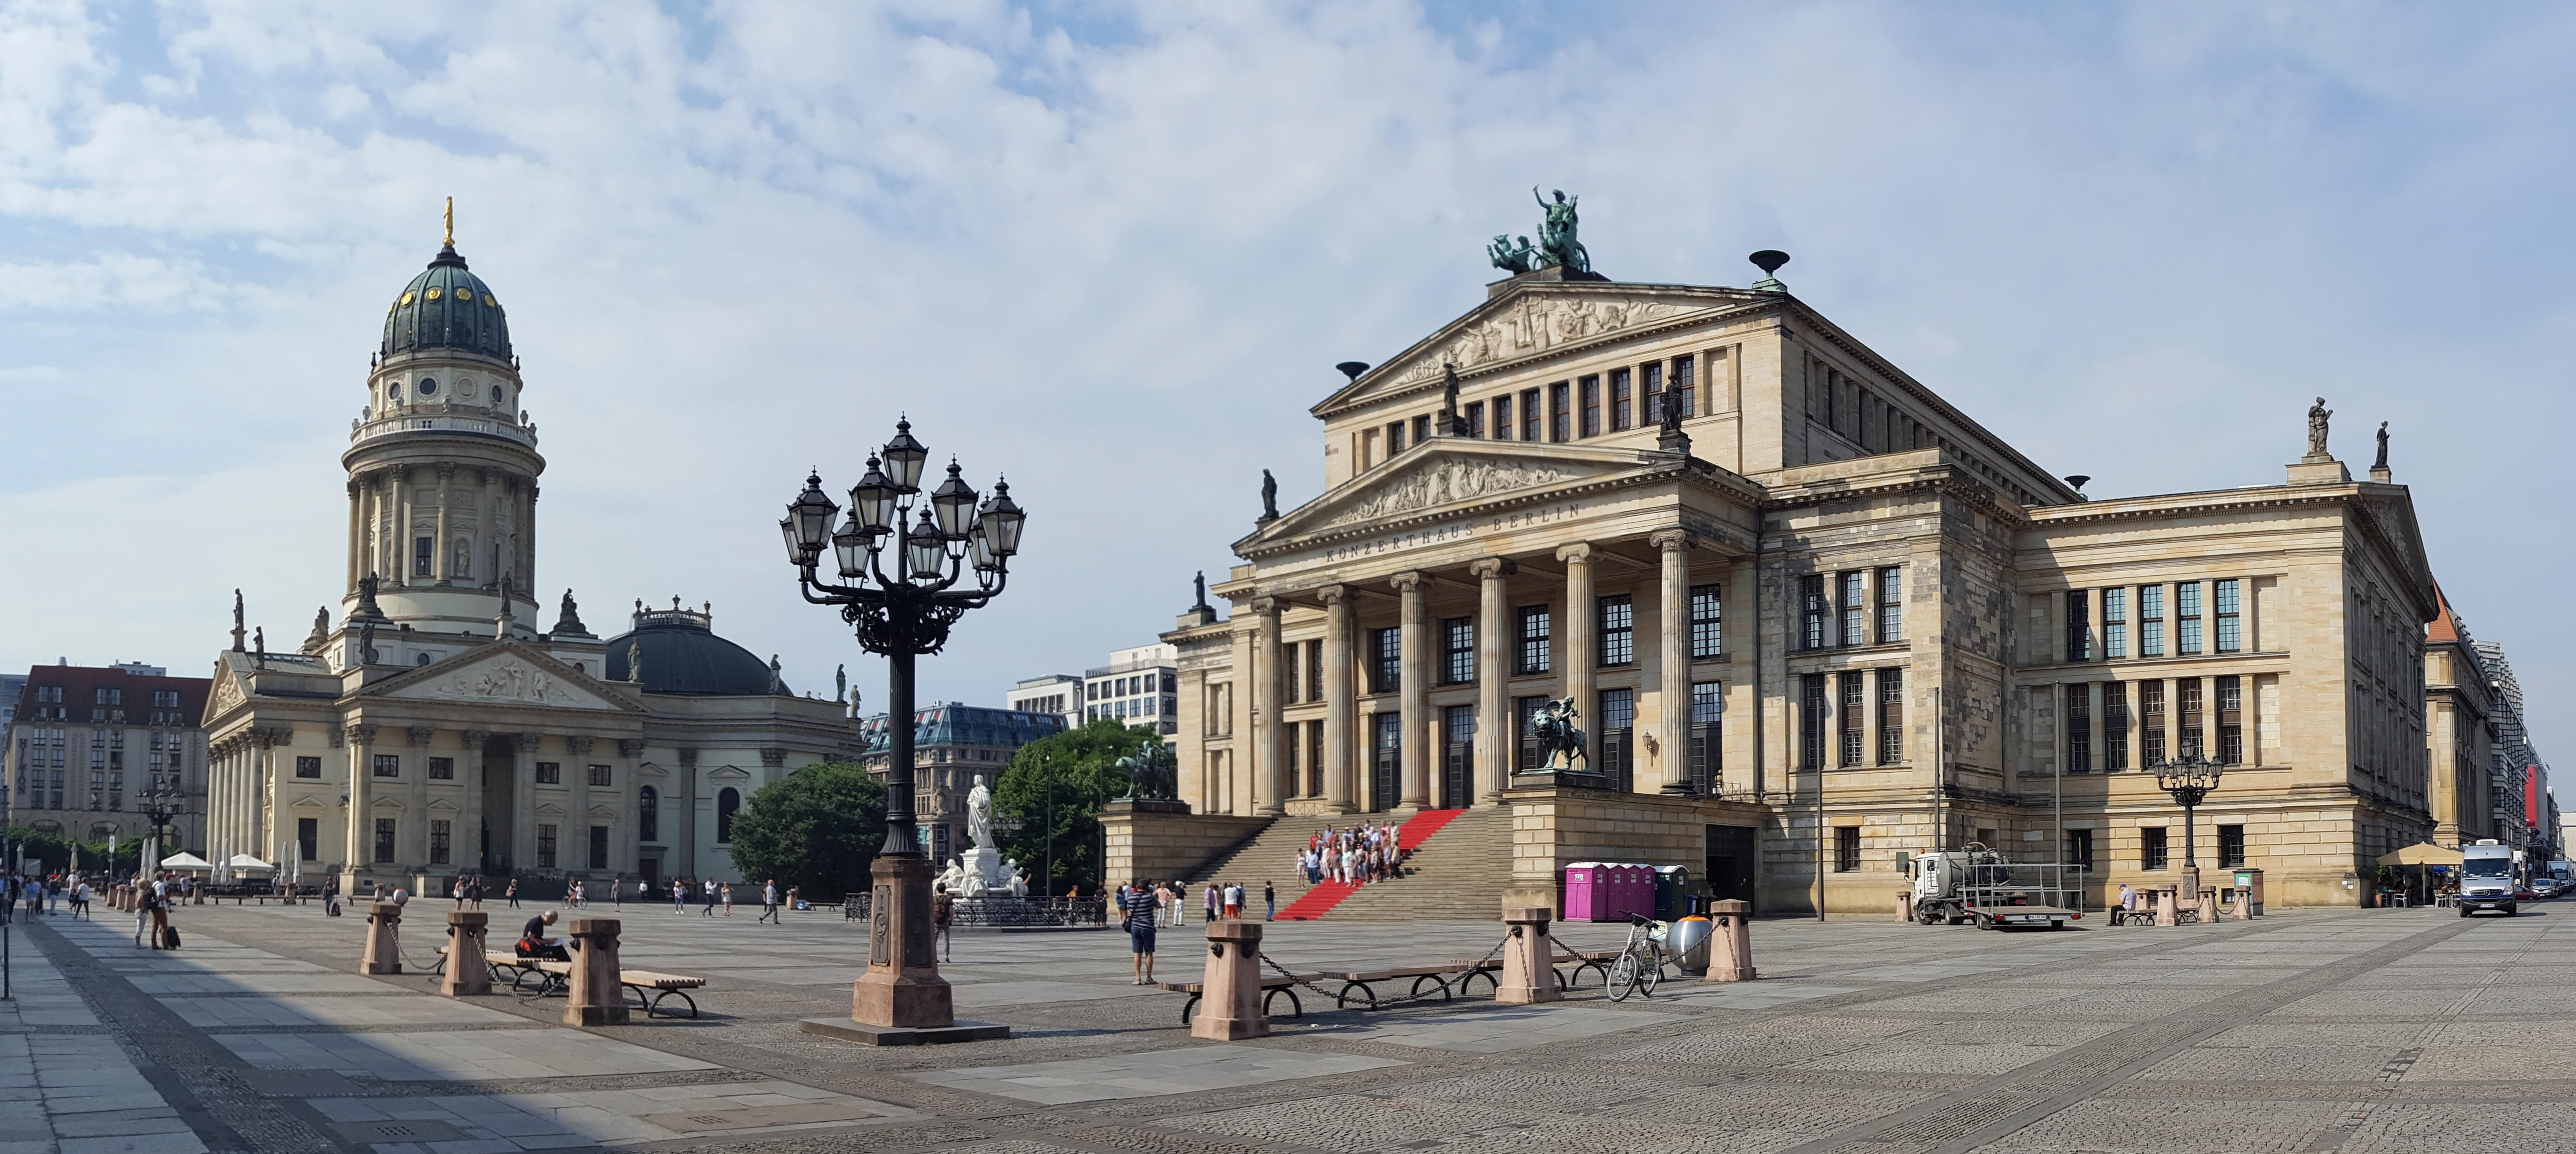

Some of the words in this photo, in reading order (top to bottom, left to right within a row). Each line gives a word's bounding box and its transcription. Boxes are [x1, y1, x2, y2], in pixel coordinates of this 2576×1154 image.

[1326, 524, 1473, 562] KONZERTHAUS
[1493, 504, 1579, 531] BERLIN
[18, 738, 27, 794] HILTON
